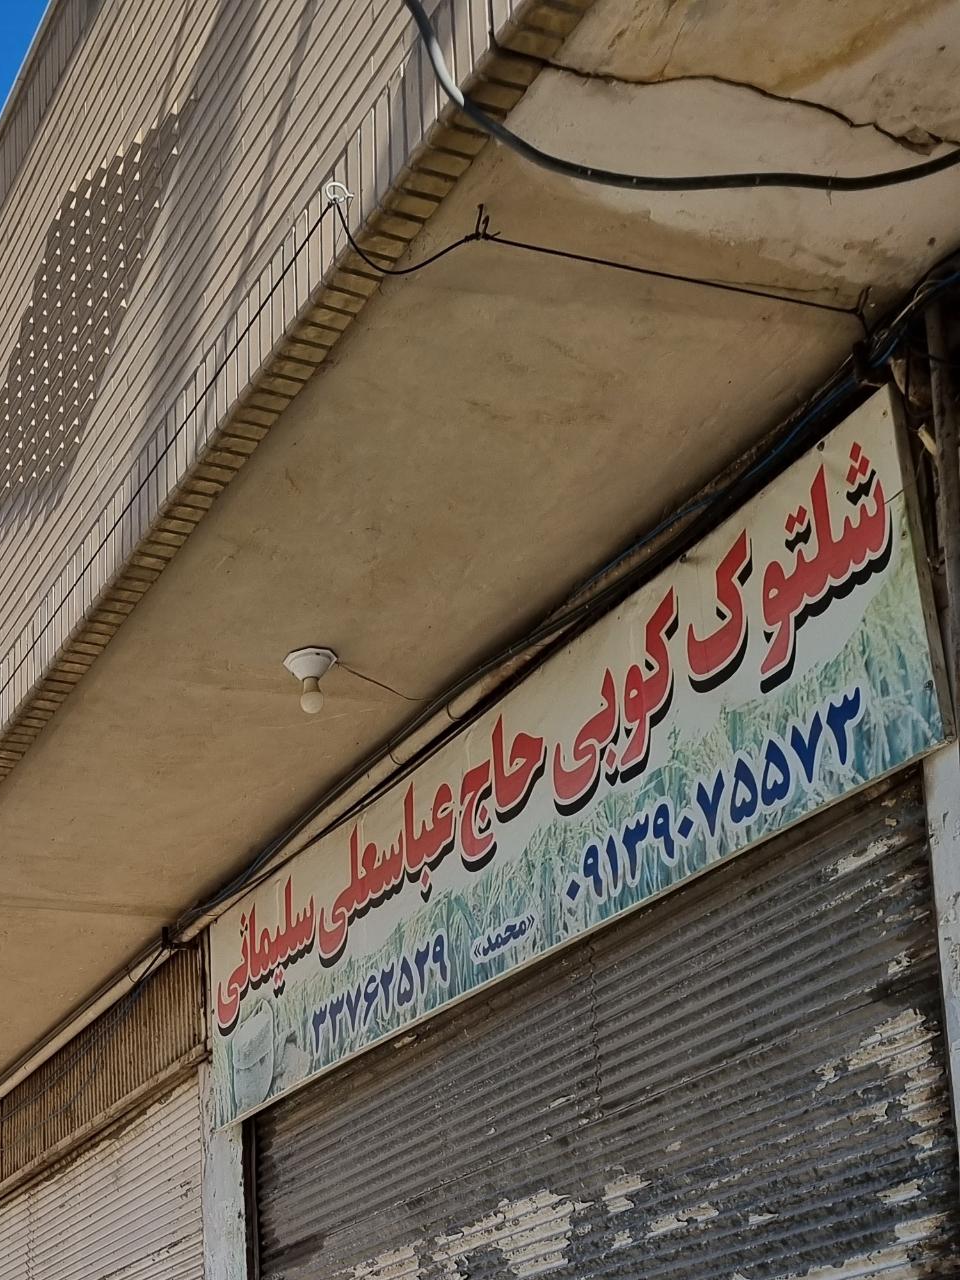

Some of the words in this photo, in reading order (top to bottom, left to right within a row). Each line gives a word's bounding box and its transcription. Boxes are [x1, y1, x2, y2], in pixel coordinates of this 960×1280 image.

[687, 442, 890, 686] شلتوک
[553, 585, 677, 806] کوبی
[318, 781, 455, 962] عباسعلی
[459, 713, 546, 864] حاج
[565, 686, 862, 901] ۰۹۱۳۹۰۷۵۵۷۳
[217, 874, 316, 1030] سلیمانی
[311, 933, 448, 1054] ۳۳۷۶۲۵۲۹
